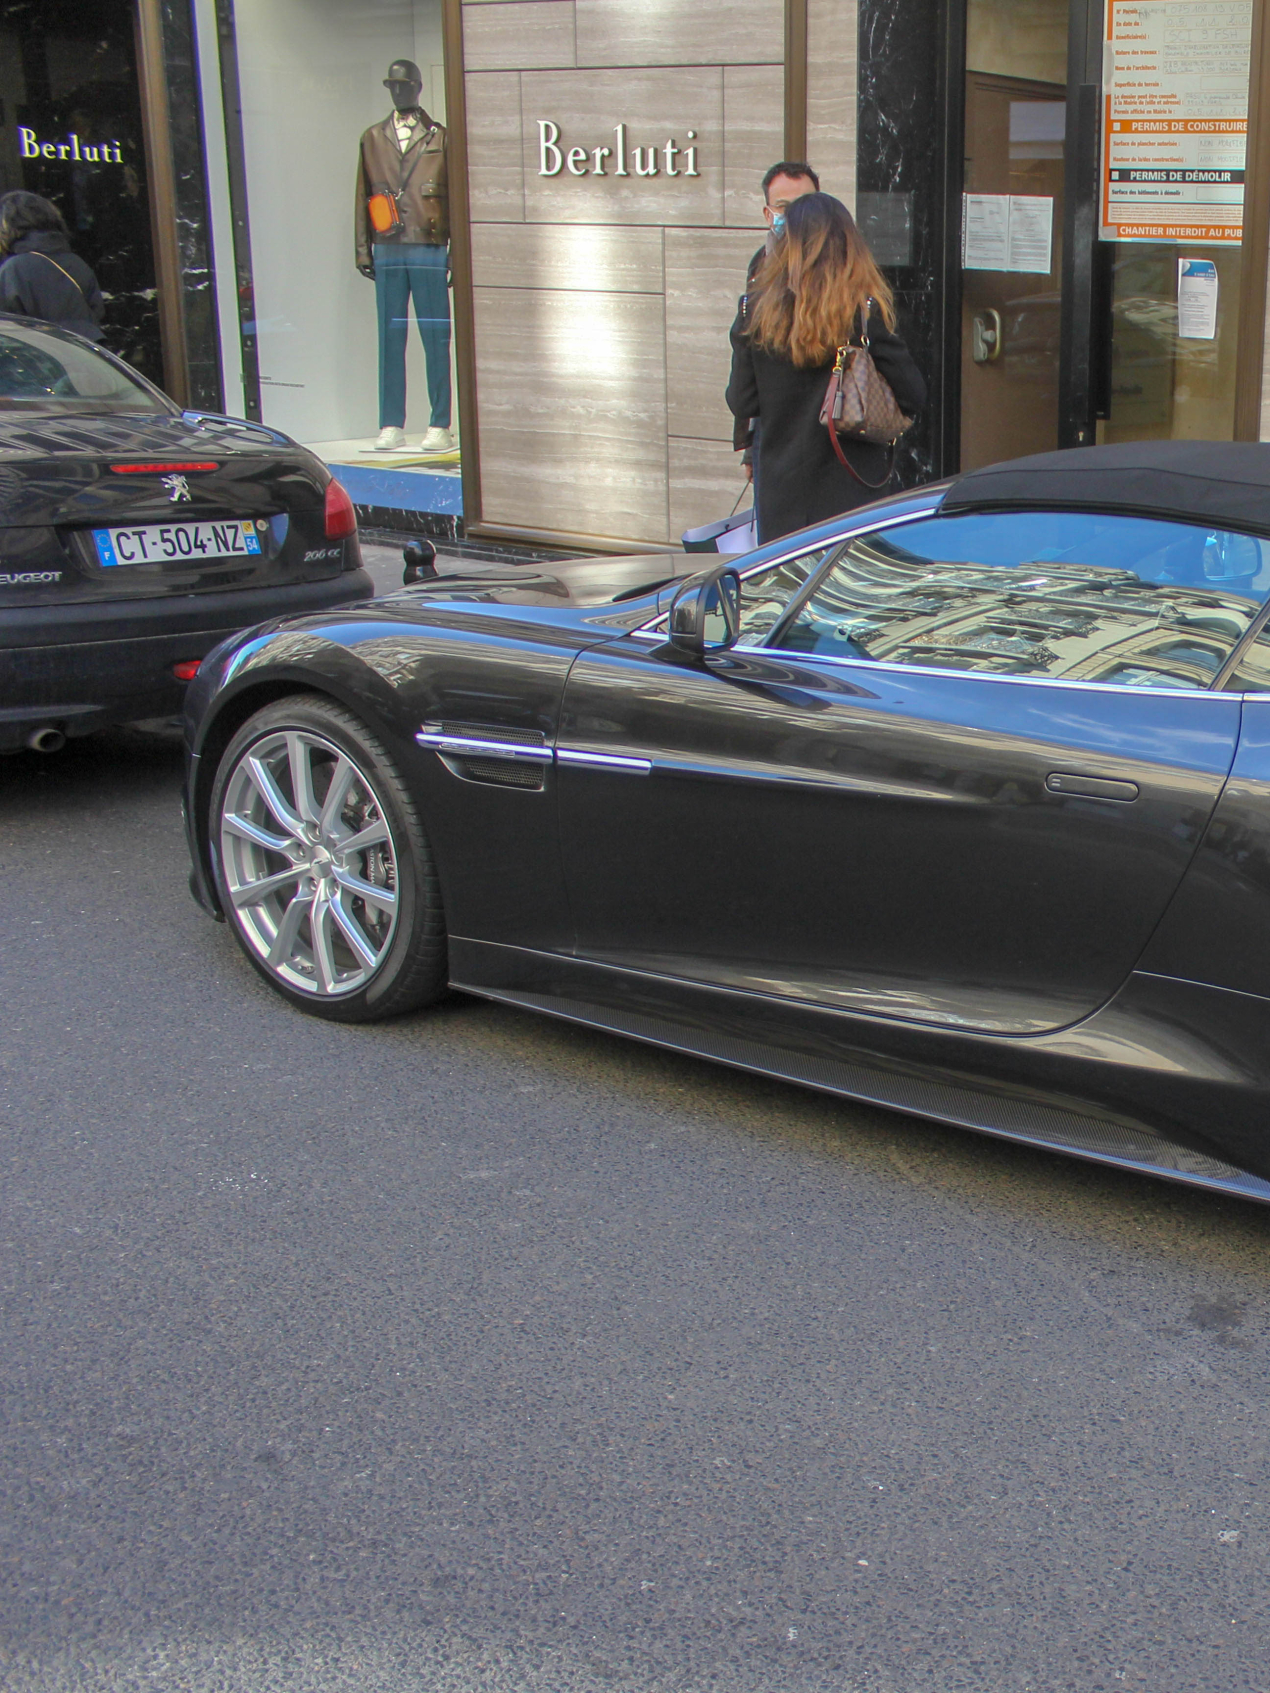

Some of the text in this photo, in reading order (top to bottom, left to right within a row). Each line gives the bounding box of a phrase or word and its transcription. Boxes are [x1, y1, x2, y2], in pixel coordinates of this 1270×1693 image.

[1132, 122, 1247, 131] PERMIS DE CONSTRUIRE
[18, 126, 124, 163] Berluti
[536, 119, 701, 177] Berluti
[1130, 170, 1231, 182] PERMIS DE DÉMOLIR
[1120, 226, 1242, 237] CHANTIER INTERDIT AU PUB
[116, 524, 245, 561] CT-504-NZ
[246, 538, 258, 550] 54
[104, 552, 111, 560] F
[304, 552, 326, 562] 206
